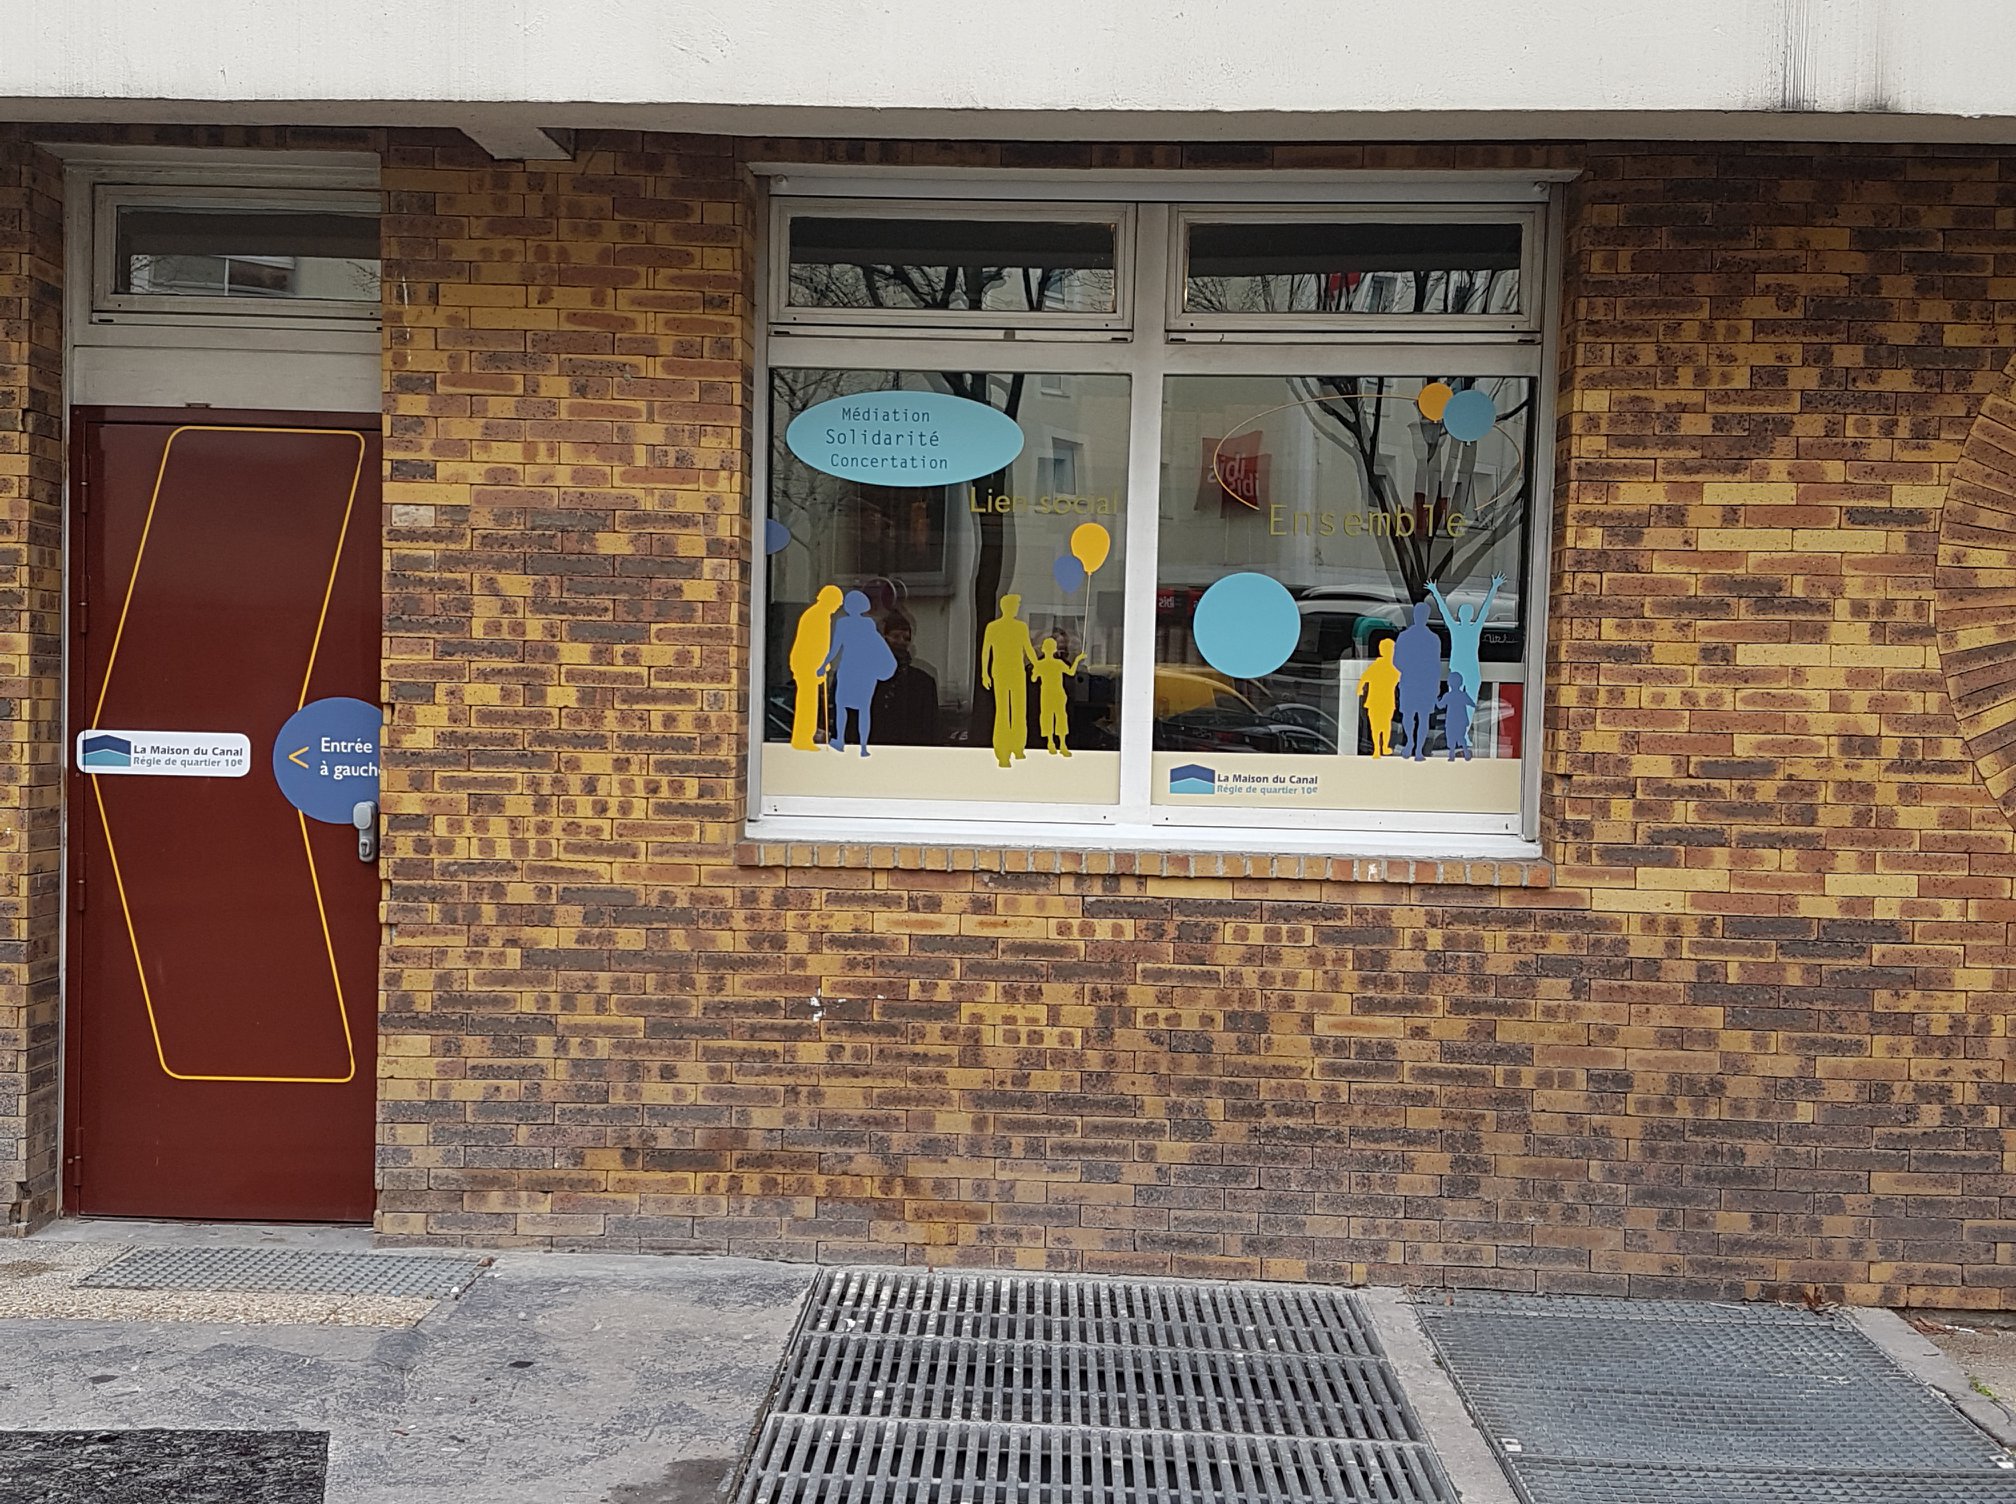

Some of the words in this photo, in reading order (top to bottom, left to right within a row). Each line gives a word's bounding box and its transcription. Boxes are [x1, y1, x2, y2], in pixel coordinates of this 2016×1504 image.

[842, 407, 930, 422] Médiation
[825, 428, 939, 447] Solidarité
[830, 453, 948, 469] Concertation
[970, 486, 1028, 513] Lien
[1040, 487, 1118, 515] social
[1268, 503, 1468, 538] Ensemble
[133, 745, 147, 755] La
[150, 745, 190, 756] Maison
[193, 746, 208, 756] du
[212, 746, 243, 757] Canal
[321, 737, 373, 753] Entrée
[164, 757, 178, 766] de
[180, 758, 222, 769] quartier
[320, 760, 329, 776] à
[333, 762, 381, 780] gauch
[1217, 773, 1230, 783] La
[1232, 773, 1269, 784] Maison
[1272, 774, 1286, 784] du
[1289, 775, 1318, 785] Canal
[1245, 785, 1257, 794] de
[1260, 785, 1298, 796] quartier
